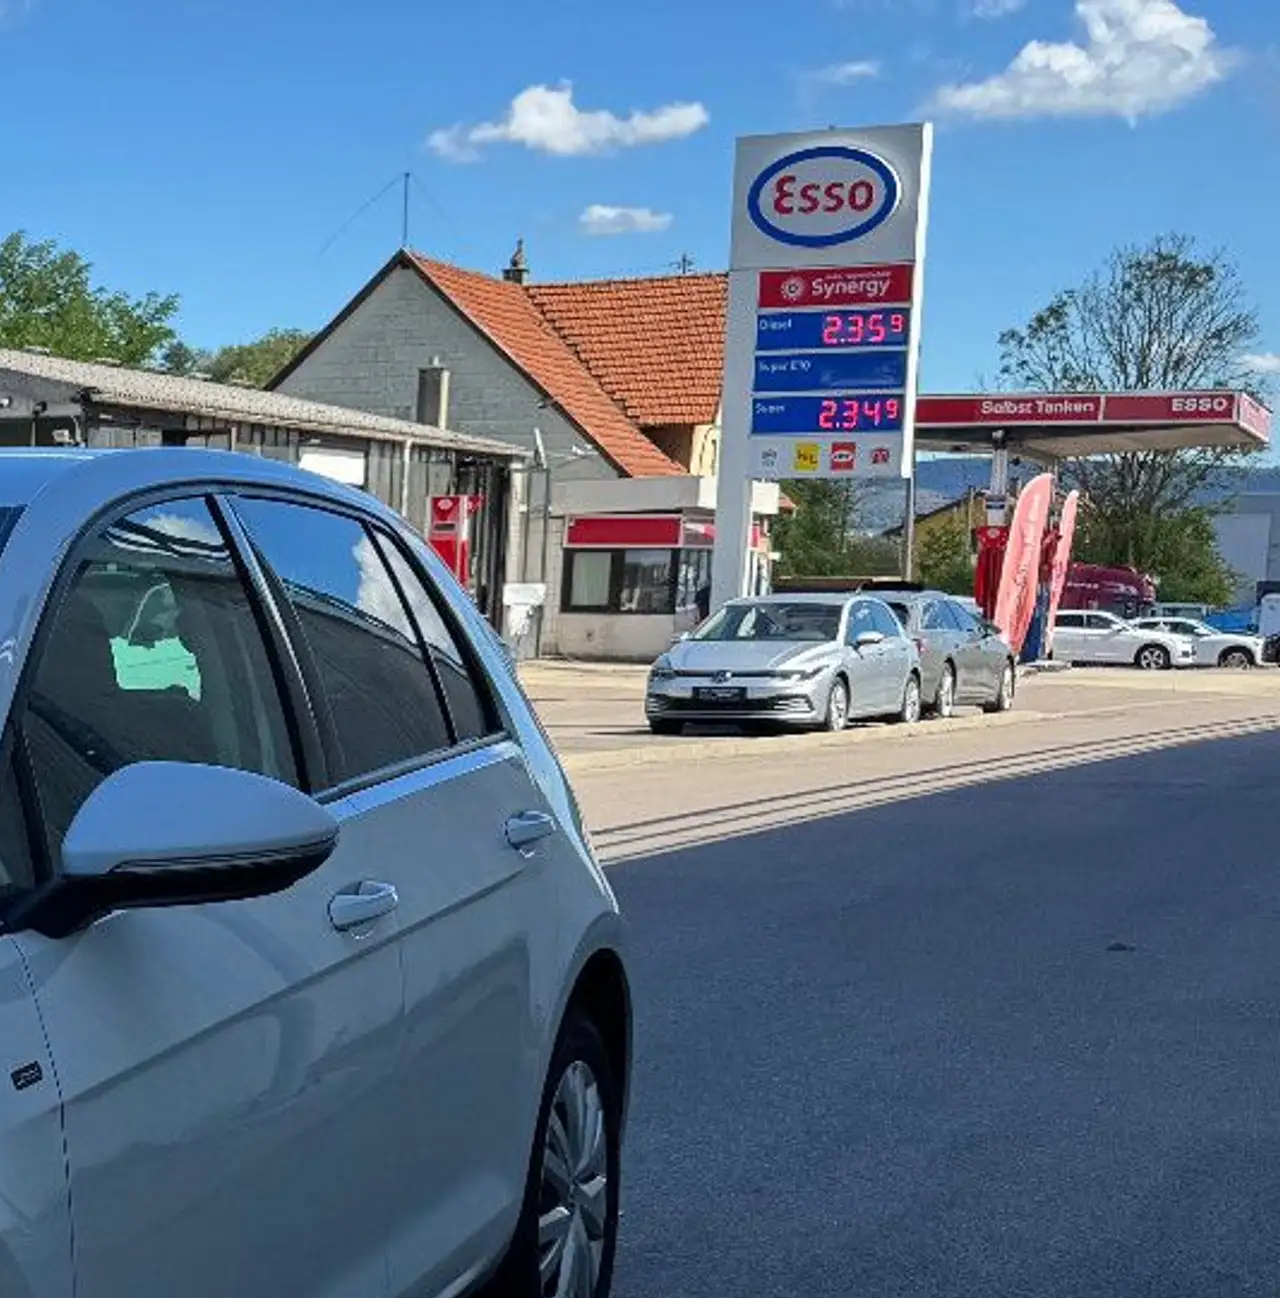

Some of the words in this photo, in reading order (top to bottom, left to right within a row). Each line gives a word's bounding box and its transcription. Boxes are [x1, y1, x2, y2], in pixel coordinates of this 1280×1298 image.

[774, 175, 874, 215] Esso
[812, 278, 891, 299] Synergy
[1035, 398, 1096, 414] Tanken
[1172, 398, 1229, 412] ESSO
